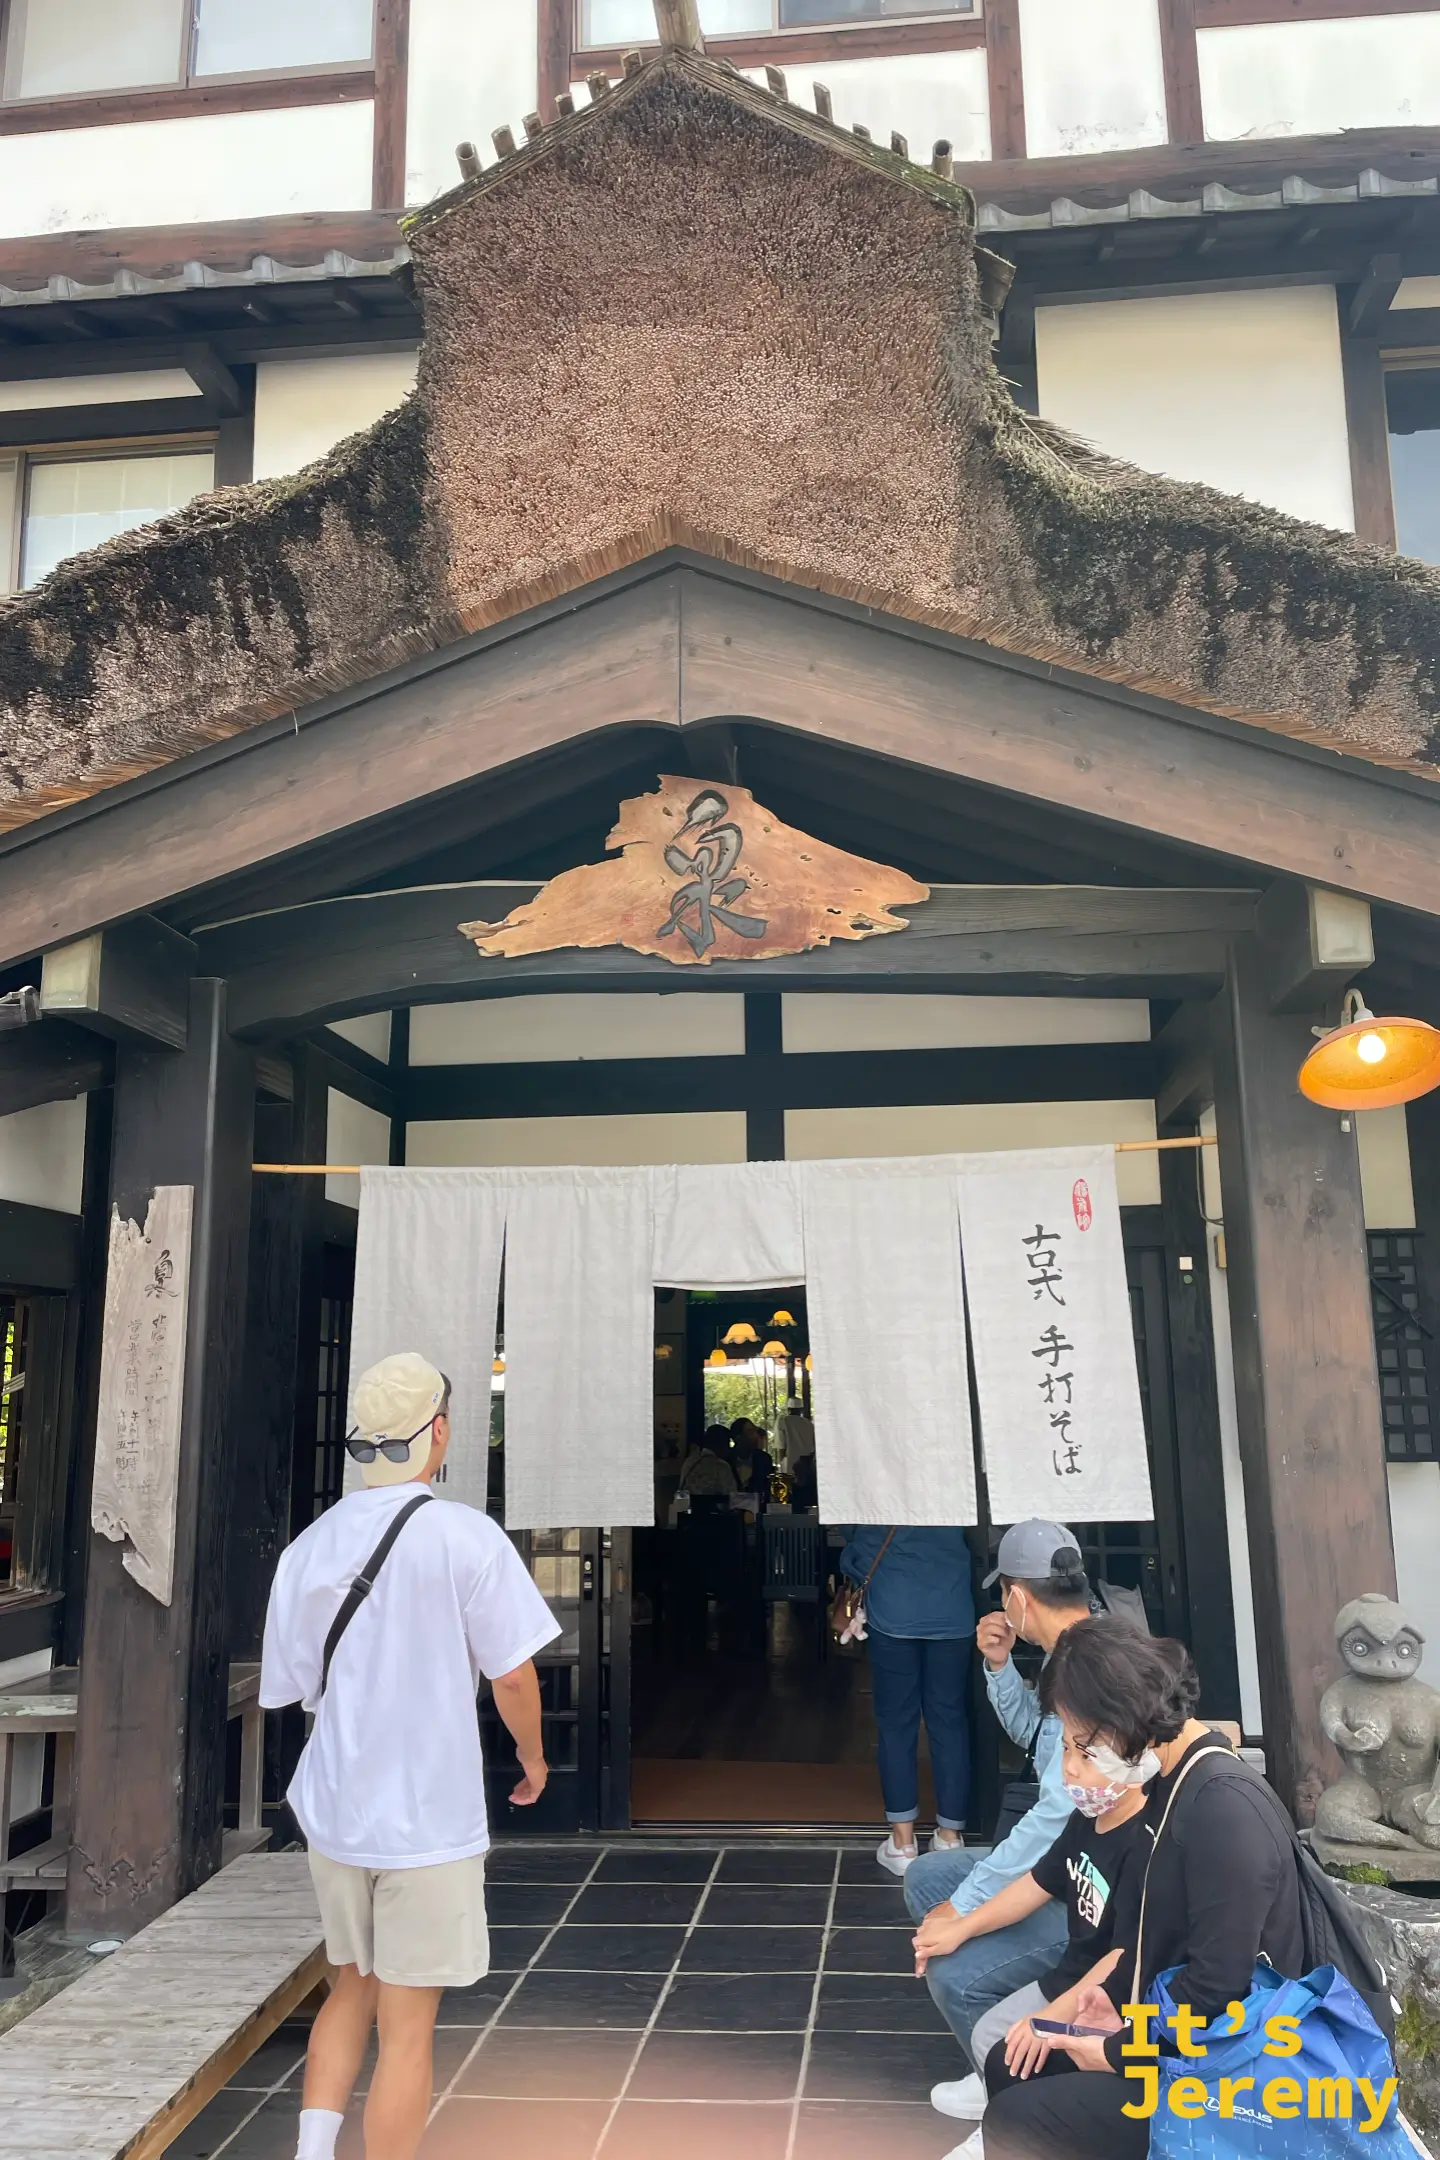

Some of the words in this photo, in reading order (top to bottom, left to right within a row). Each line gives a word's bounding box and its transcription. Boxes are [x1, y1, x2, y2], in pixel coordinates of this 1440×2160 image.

[1022, 1224, 1066, 1306] 古式
[1031, 1325, 1082, 1475] 手打そば
[1233, 2105, 1273, 2123] EXUS
